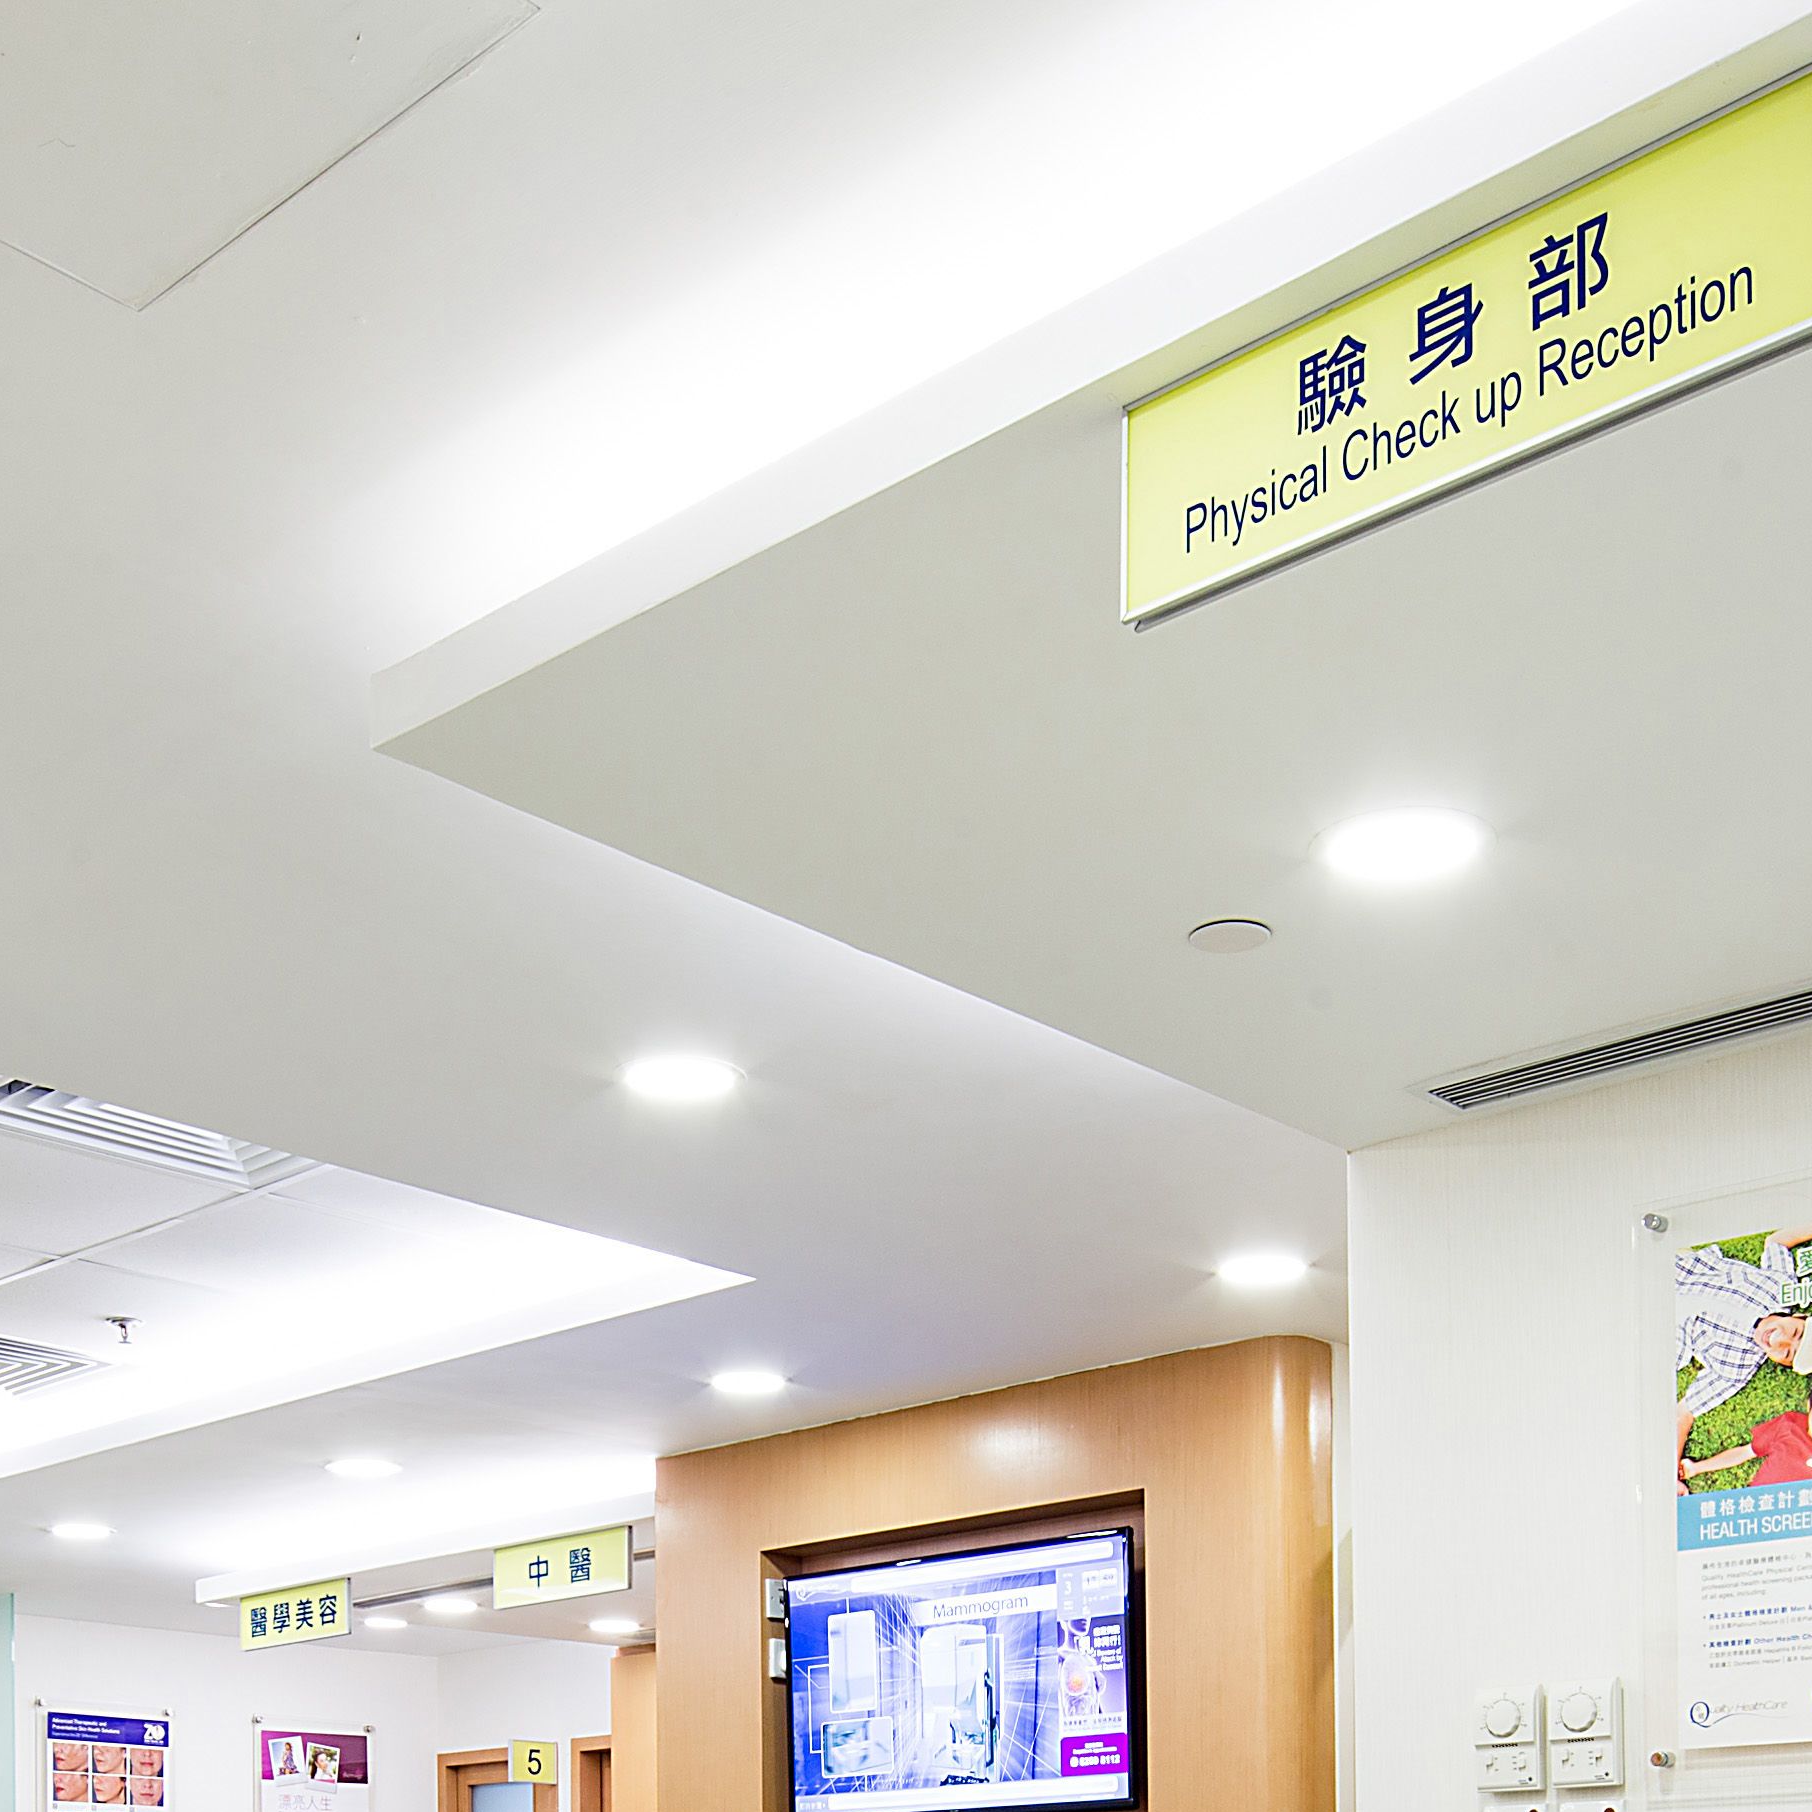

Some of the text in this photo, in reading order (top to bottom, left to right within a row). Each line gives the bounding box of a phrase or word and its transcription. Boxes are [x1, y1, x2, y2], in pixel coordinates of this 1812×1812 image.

[1296, 212, 1609, 436] 驗身部
[1186, 265, 1755, 553] Physical Check up Reception
[1700, 1518, 1758, 1541] HEALTH
[529, 1547, 591, 1588] 中醫
[251, 1594, 337, 1638] 醫學美容
[933, 1594, 1029, 1619] Mammogram
[528, 1749, 542, 1775] 5
